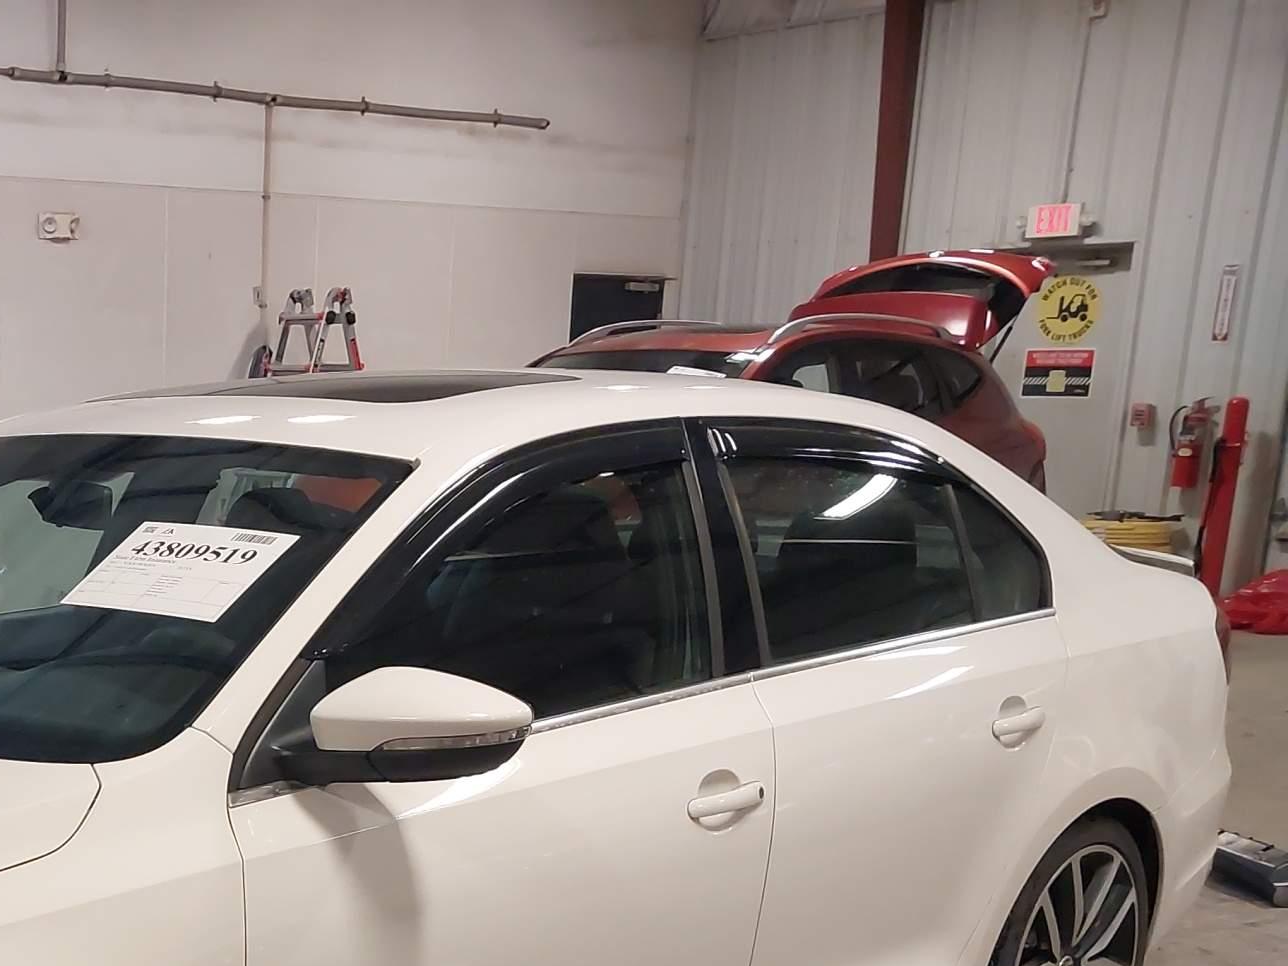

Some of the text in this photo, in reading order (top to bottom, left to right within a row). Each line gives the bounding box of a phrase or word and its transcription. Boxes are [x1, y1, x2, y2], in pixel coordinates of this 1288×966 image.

[1036, 204, 1072, 234] EXIT
[1041, 277, 1099, 301] WATCH OUT FOR
[1051, 333, 1066, 342] LIFT
[131, 540, 258, 565] 43809519
